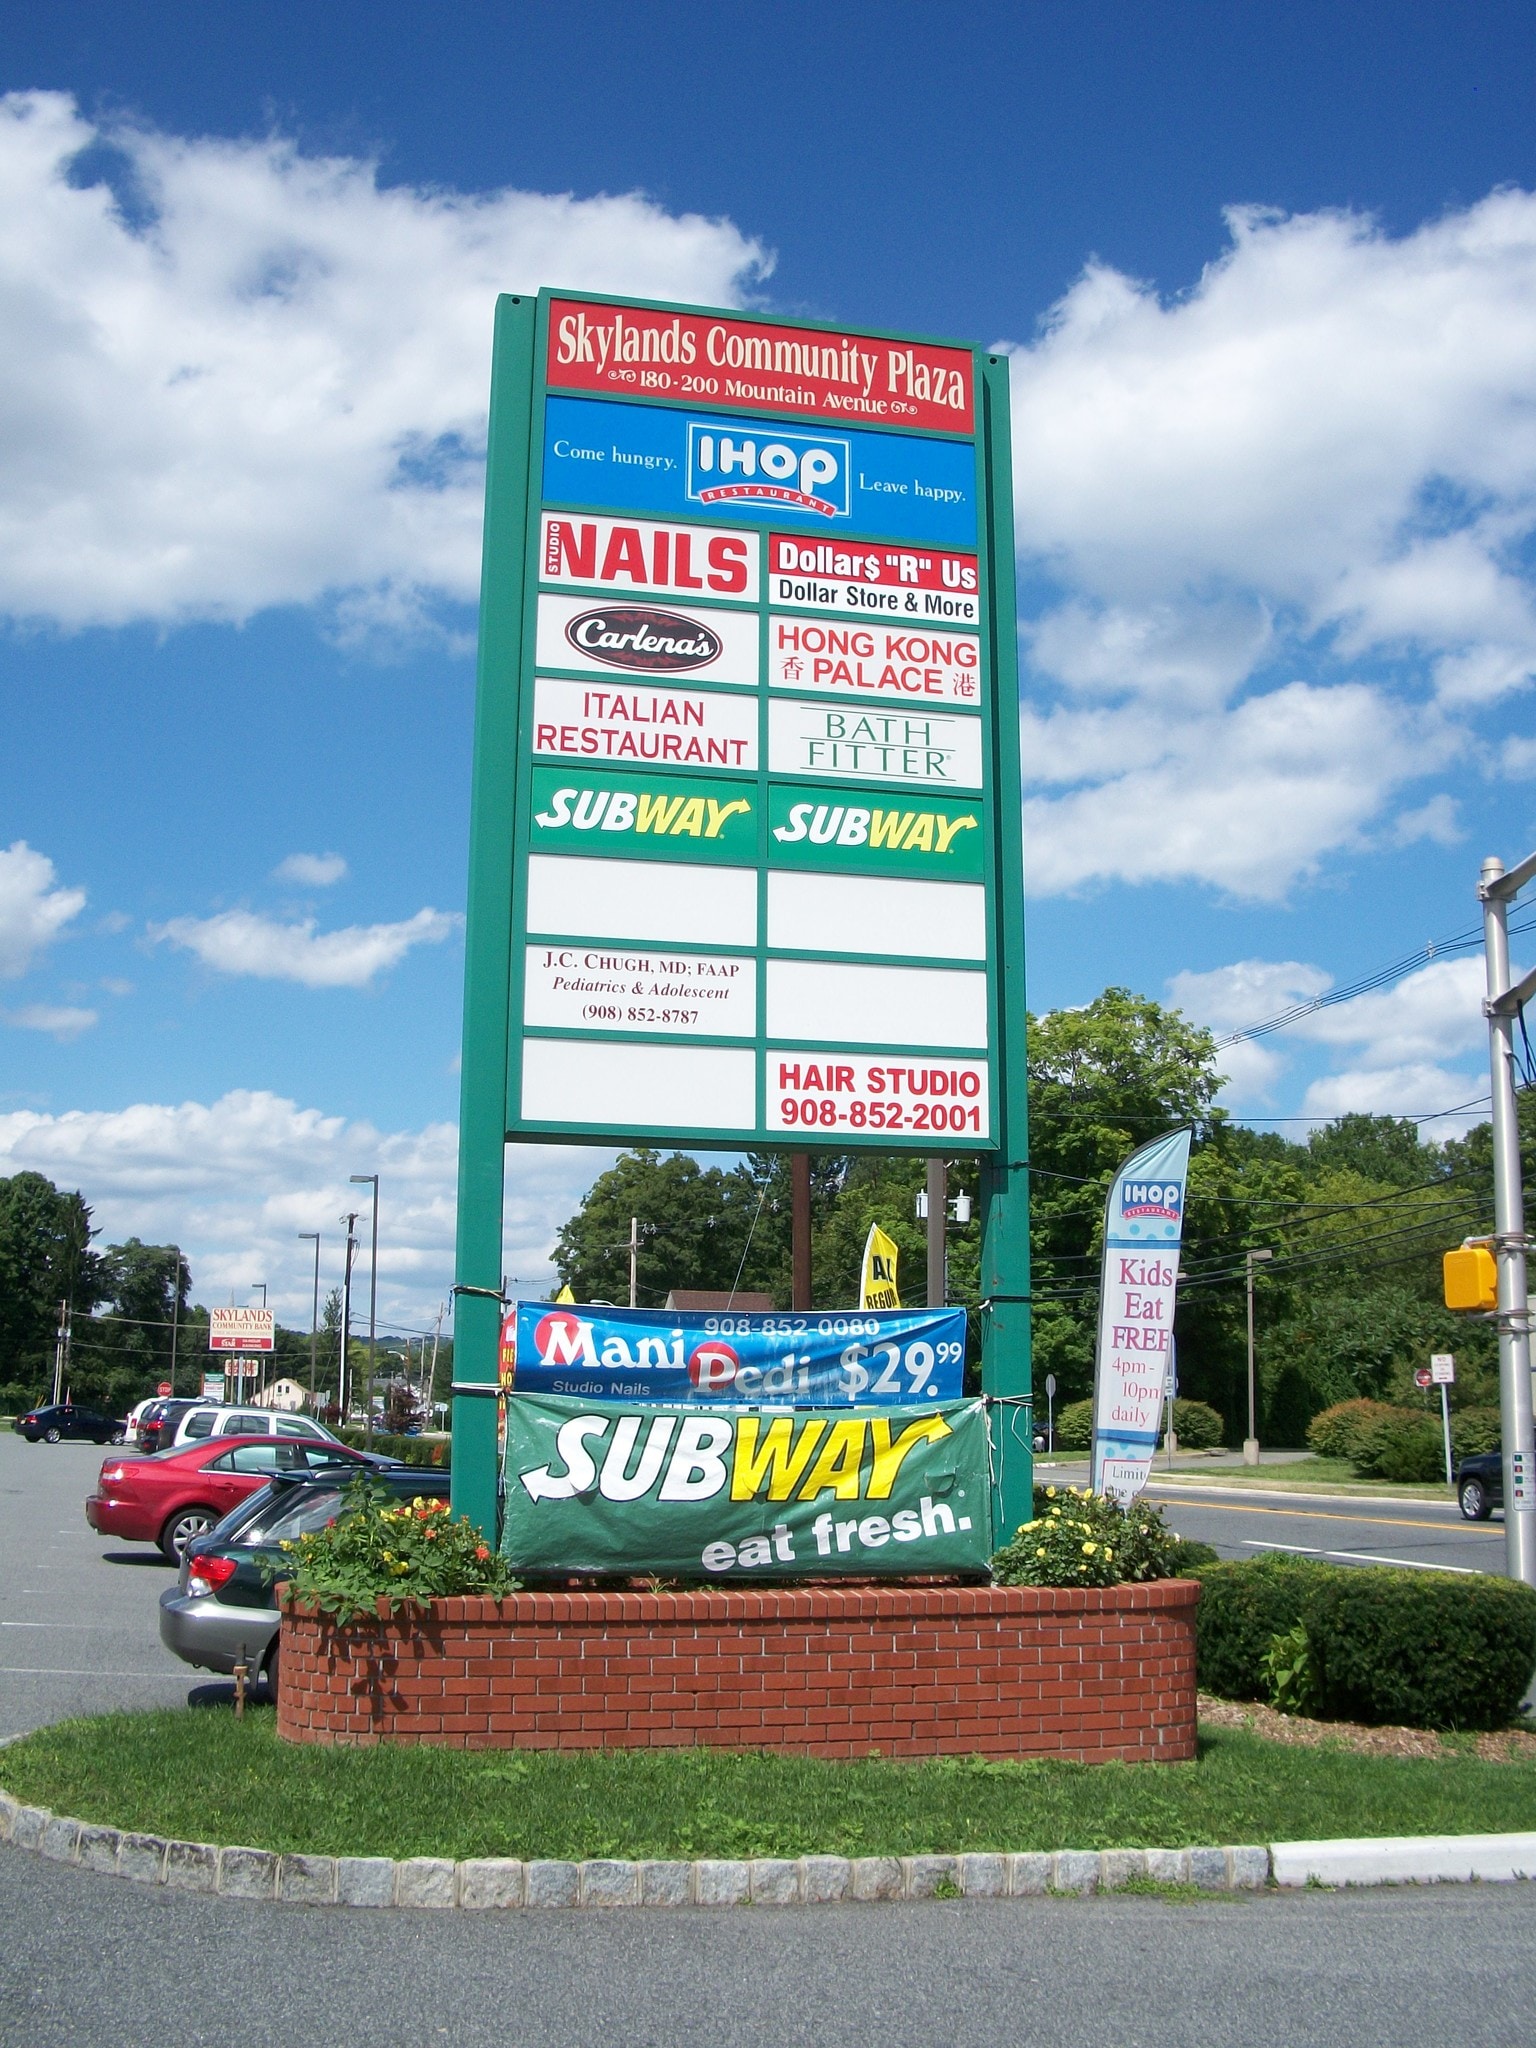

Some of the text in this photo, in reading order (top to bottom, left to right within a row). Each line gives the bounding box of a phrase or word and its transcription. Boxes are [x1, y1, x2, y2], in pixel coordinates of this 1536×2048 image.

[557, 312, 966, 410] Skylands Community Plaza
[640, 371, 888, 415] 180-200 Mountain Avenue
[553, 440, 677, 472] Come hungry.
[699, 434, 839, 495] IHOP
[706, 486, 830, 514] RESTAURANT
[859, 473, 966, 503] Leave happy.
[548, 522, 560, 574] STUDIO
[559, 520, 748, 593] NAILS
[779, 541, 977, 589] Dollar$ "R" Us
[779, 579, 975, 618] Dollar Store & More
[575, 618, 714, 659] Carlena's
[778, 625, 977, 668] HONG KONG
[780, 656, 804, 682] 香
[813, 658, 943, 695] PALACE
[953, 672, 976, 697] 港
[583, 692, 704, 726] ITALIAN
[537, 724, 748, 765] RESTAURANT
[826, 712, 931, 746] BATH
[808, 741, 946, 777] FITTER
[535, 788, 751, 837] SUBWAY
[772, 803, 978, 853] SUBWAY
[543, 951, 578, 969] J.C.
[584, 953, 655, 976] CHUGH,
[697, 962, 740, 978] FAAP
[552, 976, 730, 1000] Pediatrics & Adolescent
[582, 1003, 699, 1025] (908) 852-8787
[779, 1063, 981, 1098] HAIR STUDIO
[781, 1098, 981, 1132] 908-852-2001
[1125, 1184, 1179, 1209] IHOP
[1118, 1258, 1173, 1287] Kids
[213, 1308, 273, 1323] SKYLANDS
[1124, 1292, 1164, 1320] Eat
[212, 1321, 253, 1330] COMMUNITY
[254, 1323, 272, 1331] BANK
[703, 1316, 880, 1337] 908-852-0080
[1111, 1325, 1169, 1351] FREE
[541, 1321, 687, 1369] Mani
[553, 1380, 651, 1396] Studio Nails
[691, 1350, 811, 1395] Pedi
[838, 1341, 963, 1401] $29.99
[1112, 1405, 1149, 1427] daily
[518, 1412, 954, 1504] SUBWAY
[701, 1496, 972, 1572] eat fresh.
